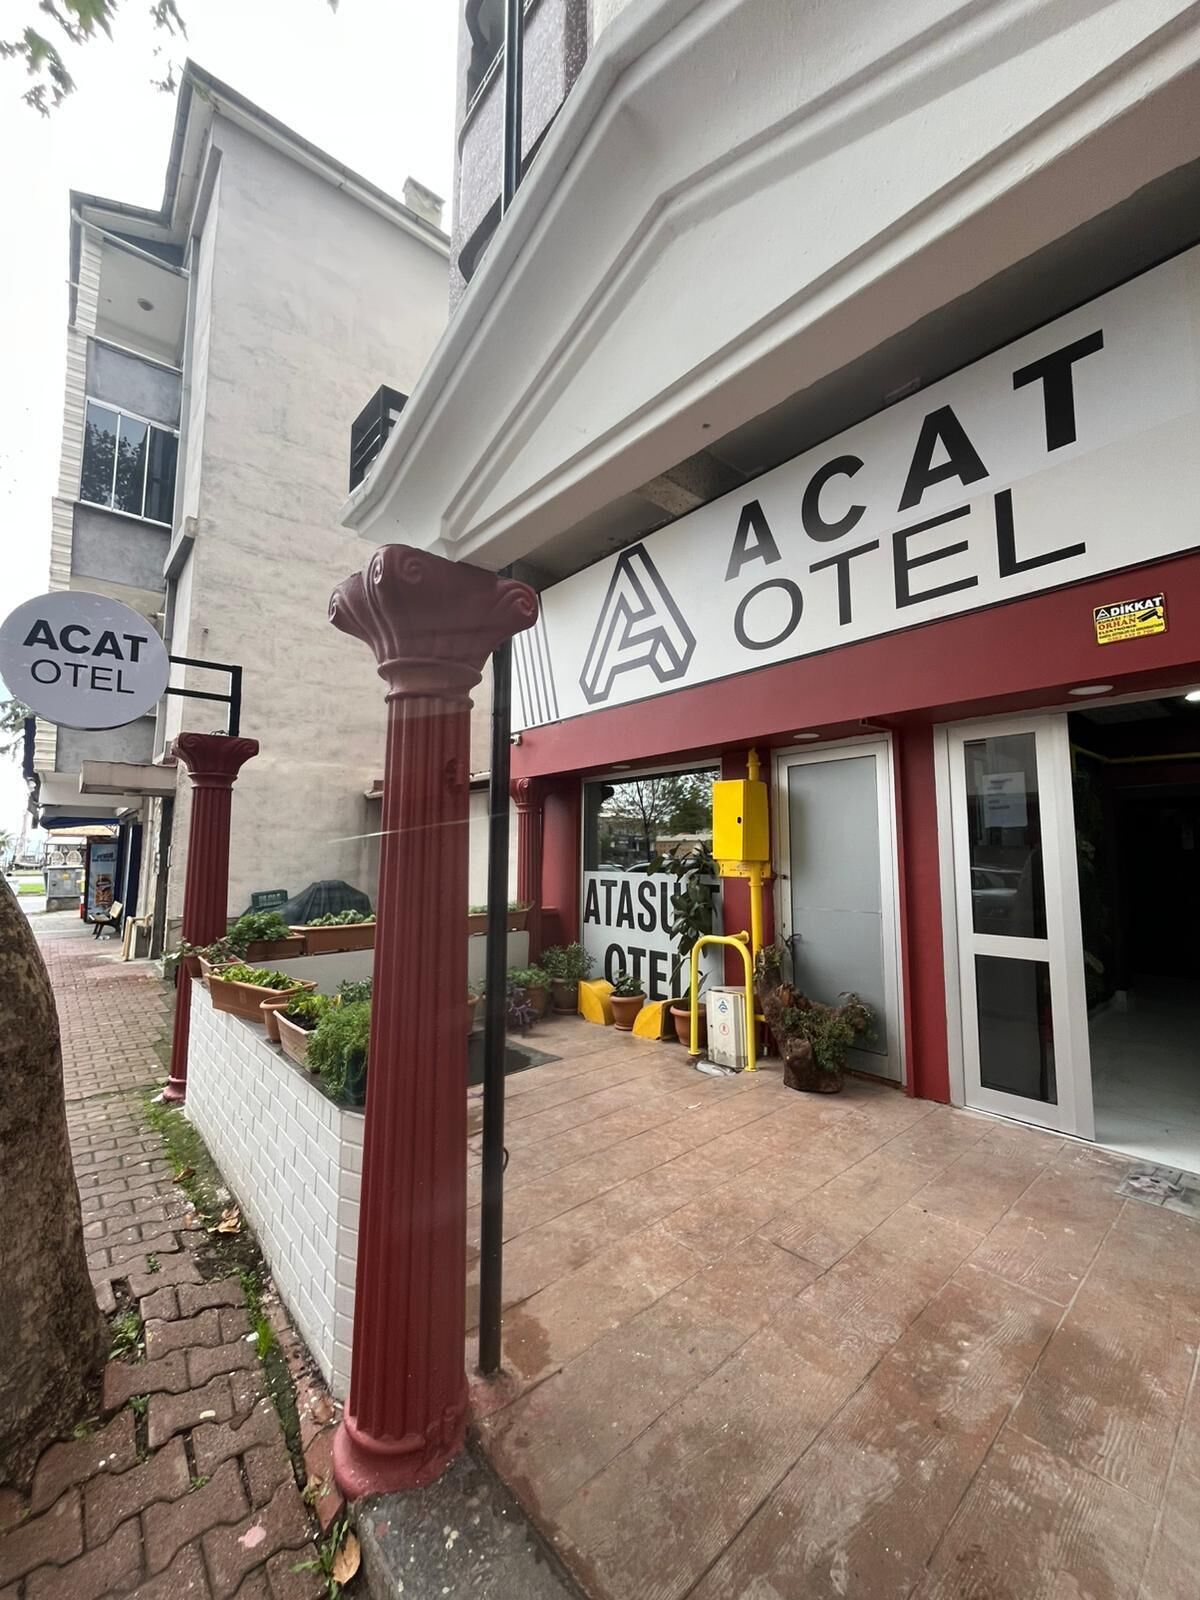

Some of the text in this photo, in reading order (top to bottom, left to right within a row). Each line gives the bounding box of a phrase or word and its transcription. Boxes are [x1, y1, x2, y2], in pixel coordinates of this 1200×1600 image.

[724, 329, 1104, 581] ACAT
[734, 488, 1086, 651] OTEL
[1098, 617, 1136, 631] ORHAN
[1110, 597, 1162, 617] DİKKAT
[22, 619, 148, 662] ACAT
[30, 659, 135, 694] OTEL
